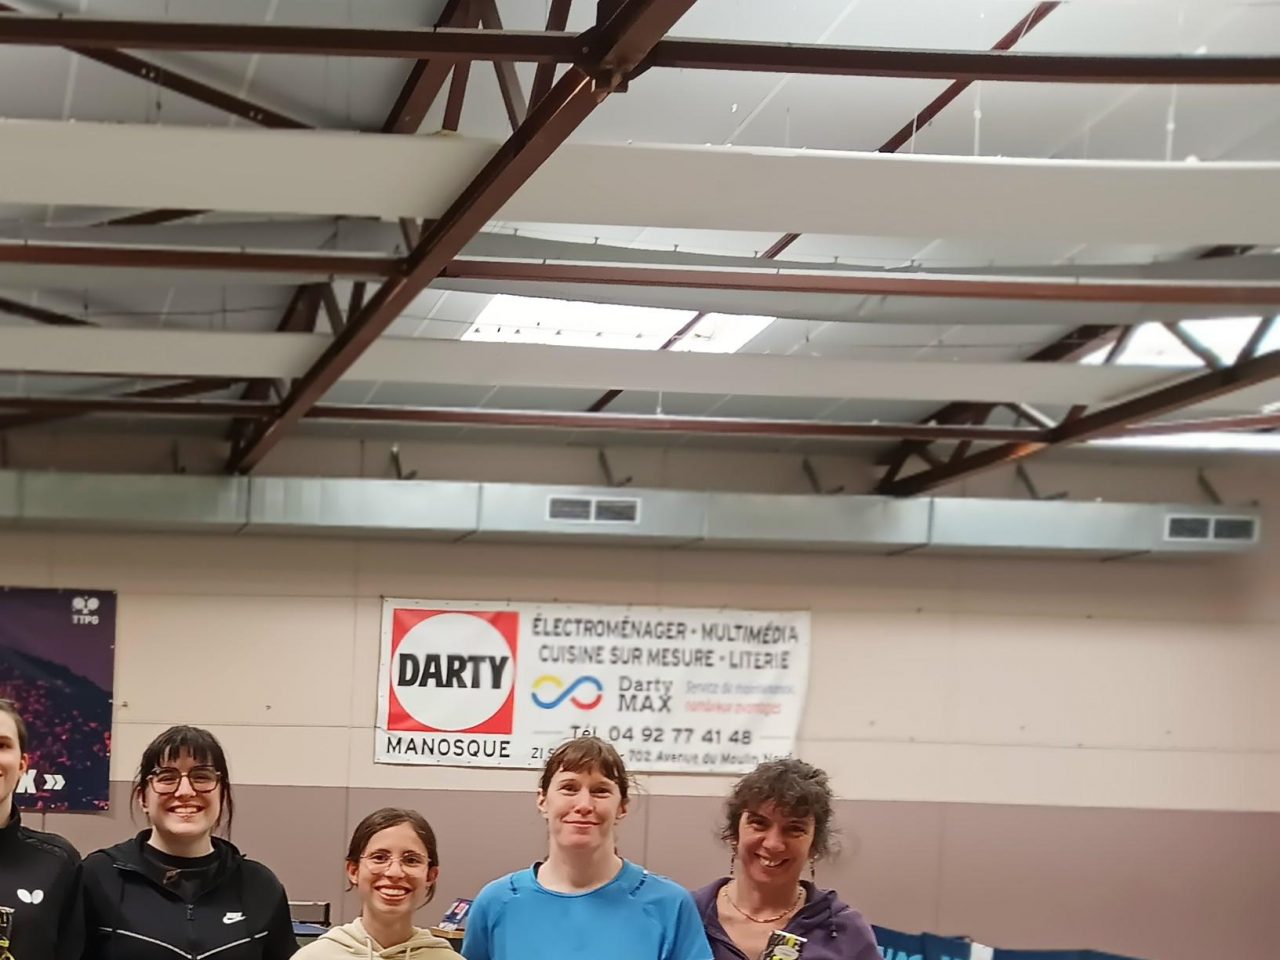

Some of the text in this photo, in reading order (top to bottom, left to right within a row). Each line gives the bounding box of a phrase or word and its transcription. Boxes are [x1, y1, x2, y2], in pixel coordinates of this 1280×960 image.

[531, 613, 799, 645] ÉLECTROMÉNAGER MULTIMÉDIA
[538, 644, 791, 669] CUISINE SUR MESURE LITERIE
[397, 653, 510, 689] DARTY
[618, 675, 673, 697] Darty
[617, 693, 672, 713] MAX
[608, 725, 634, 741] 04
[641, 727, 665, 743] 92
[671, 727, 695, 744] 77
[701, 729, 721, 745] 41
[728, 730, 752, 745] 48
[386, 736, 511, 758] MANOSQUE
